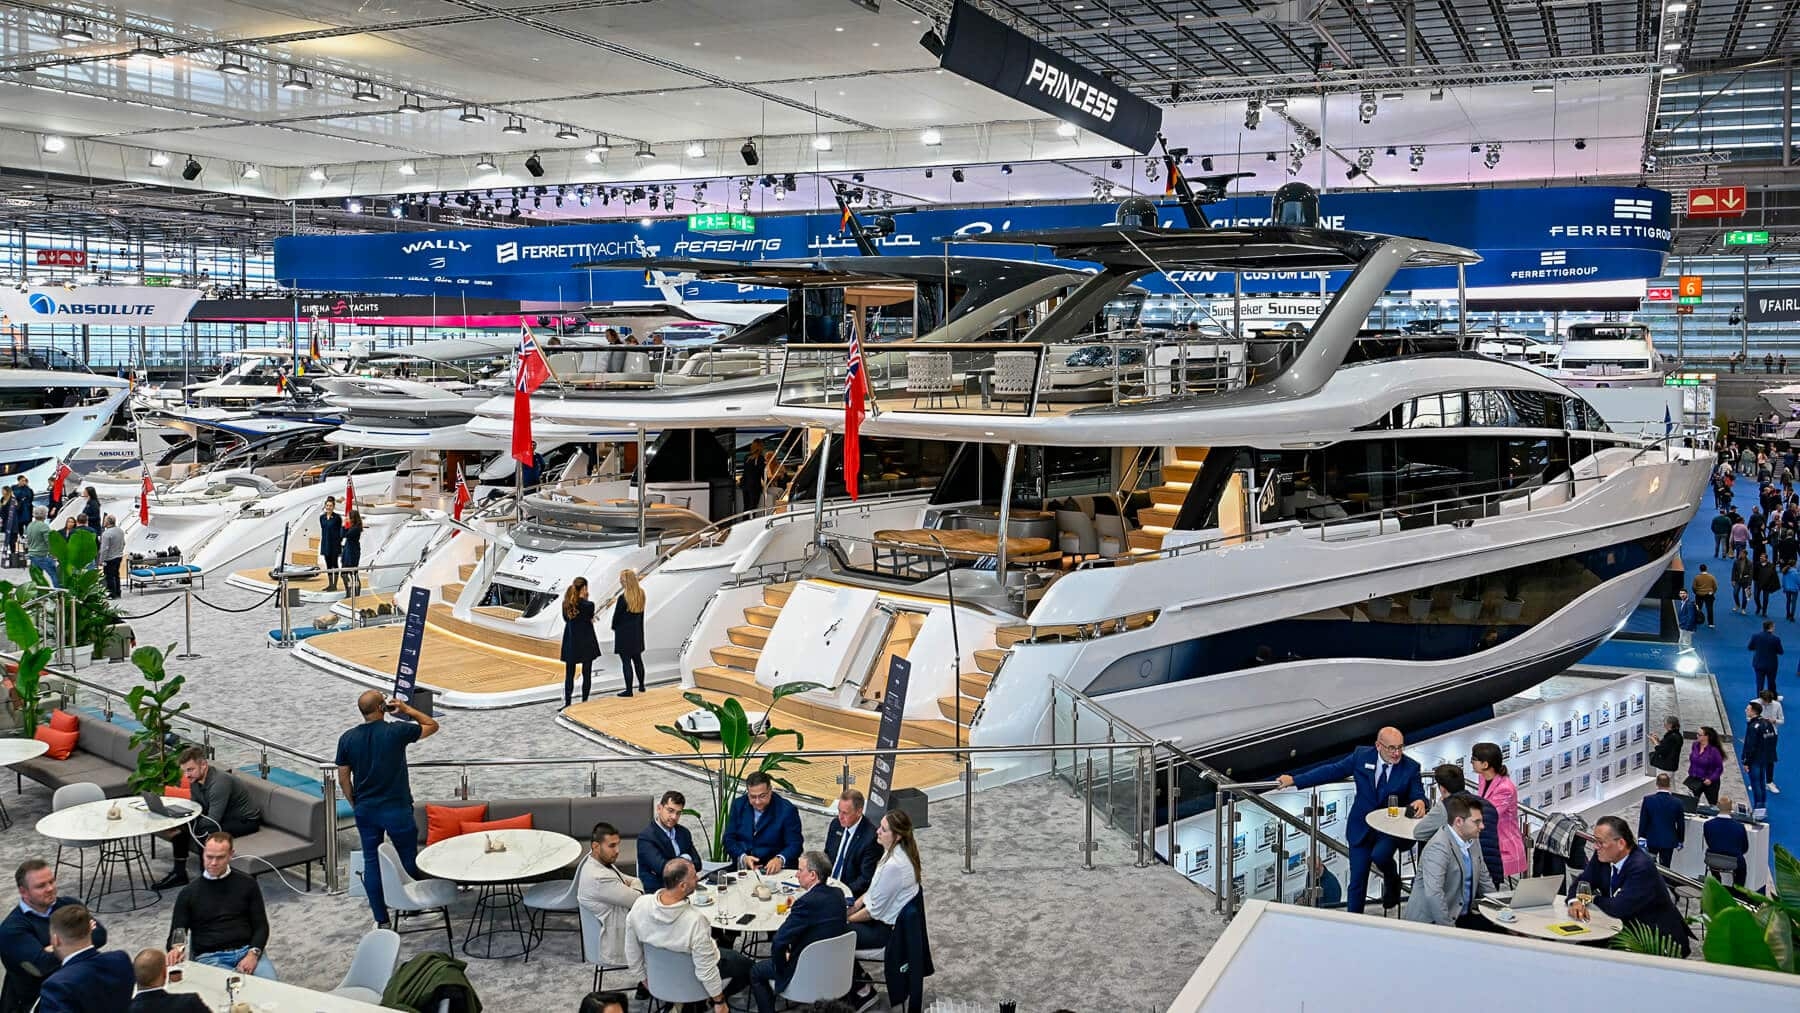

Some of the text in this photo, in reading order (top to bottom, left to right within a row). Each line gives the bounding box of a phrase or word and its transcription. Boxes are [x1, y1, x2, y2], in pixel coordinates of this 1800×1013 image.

[1025, 58, 1119, 123] PRINCESS
[402, 239, 473, 255] WALLY
[673, 238, 782, 254] PERSHING
[1511, 266, 1599, 279] FERRETTIGROUP
[1686, 282, 1696, 296] 6
[57, 303, 156, 316] ABSOLUTE
[348, 303, 380, 312] YACHTS
